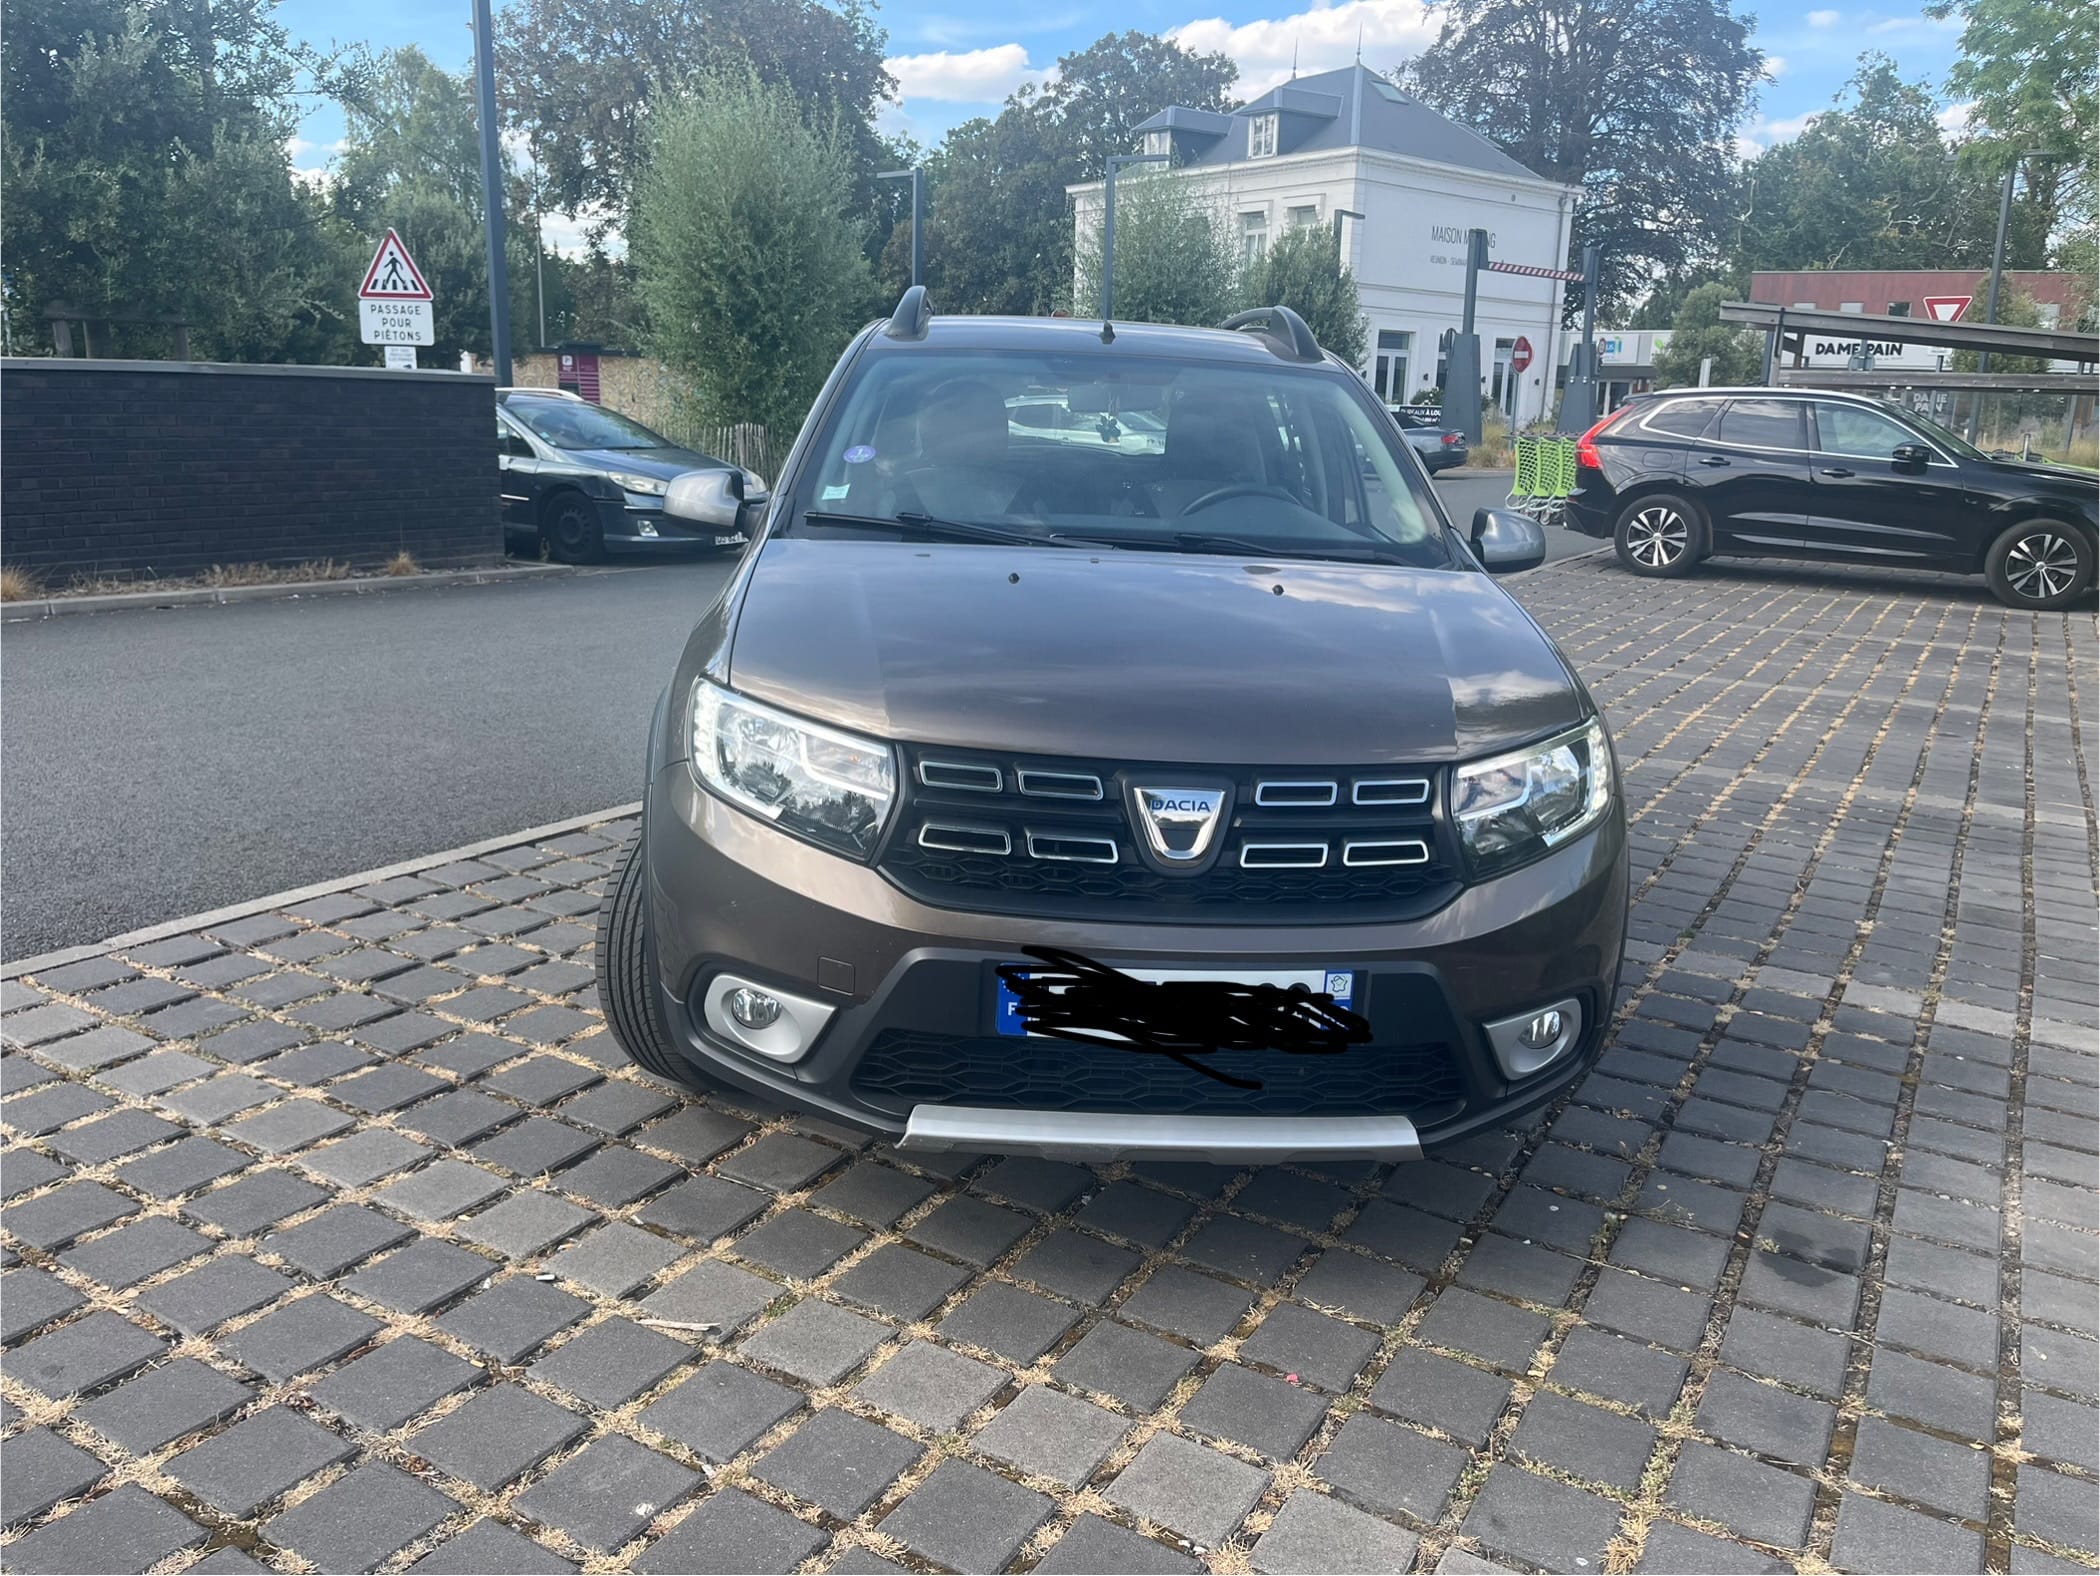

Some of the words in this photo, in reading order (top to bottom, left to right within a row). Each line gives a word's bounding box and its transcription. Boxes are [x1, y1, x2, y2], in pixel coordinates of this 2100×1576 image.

[1432, 226, 1462, 245] MAISON
[370, 304, 421, 315] PASSAGE
[382, 317, 411, 328] POUR
[374, 329, 422, 341] PIÉTONS
[1815, 343, 1860, 356] DAME
[1867, 343, 1903, 356] PAIN
[1913, 392, 1948, 403] DAE
[1914, 403, 1943, 413] PAN
[1151, 800, 1211, 812] DACIA
[1007, 1002, 1017, 1015] F
